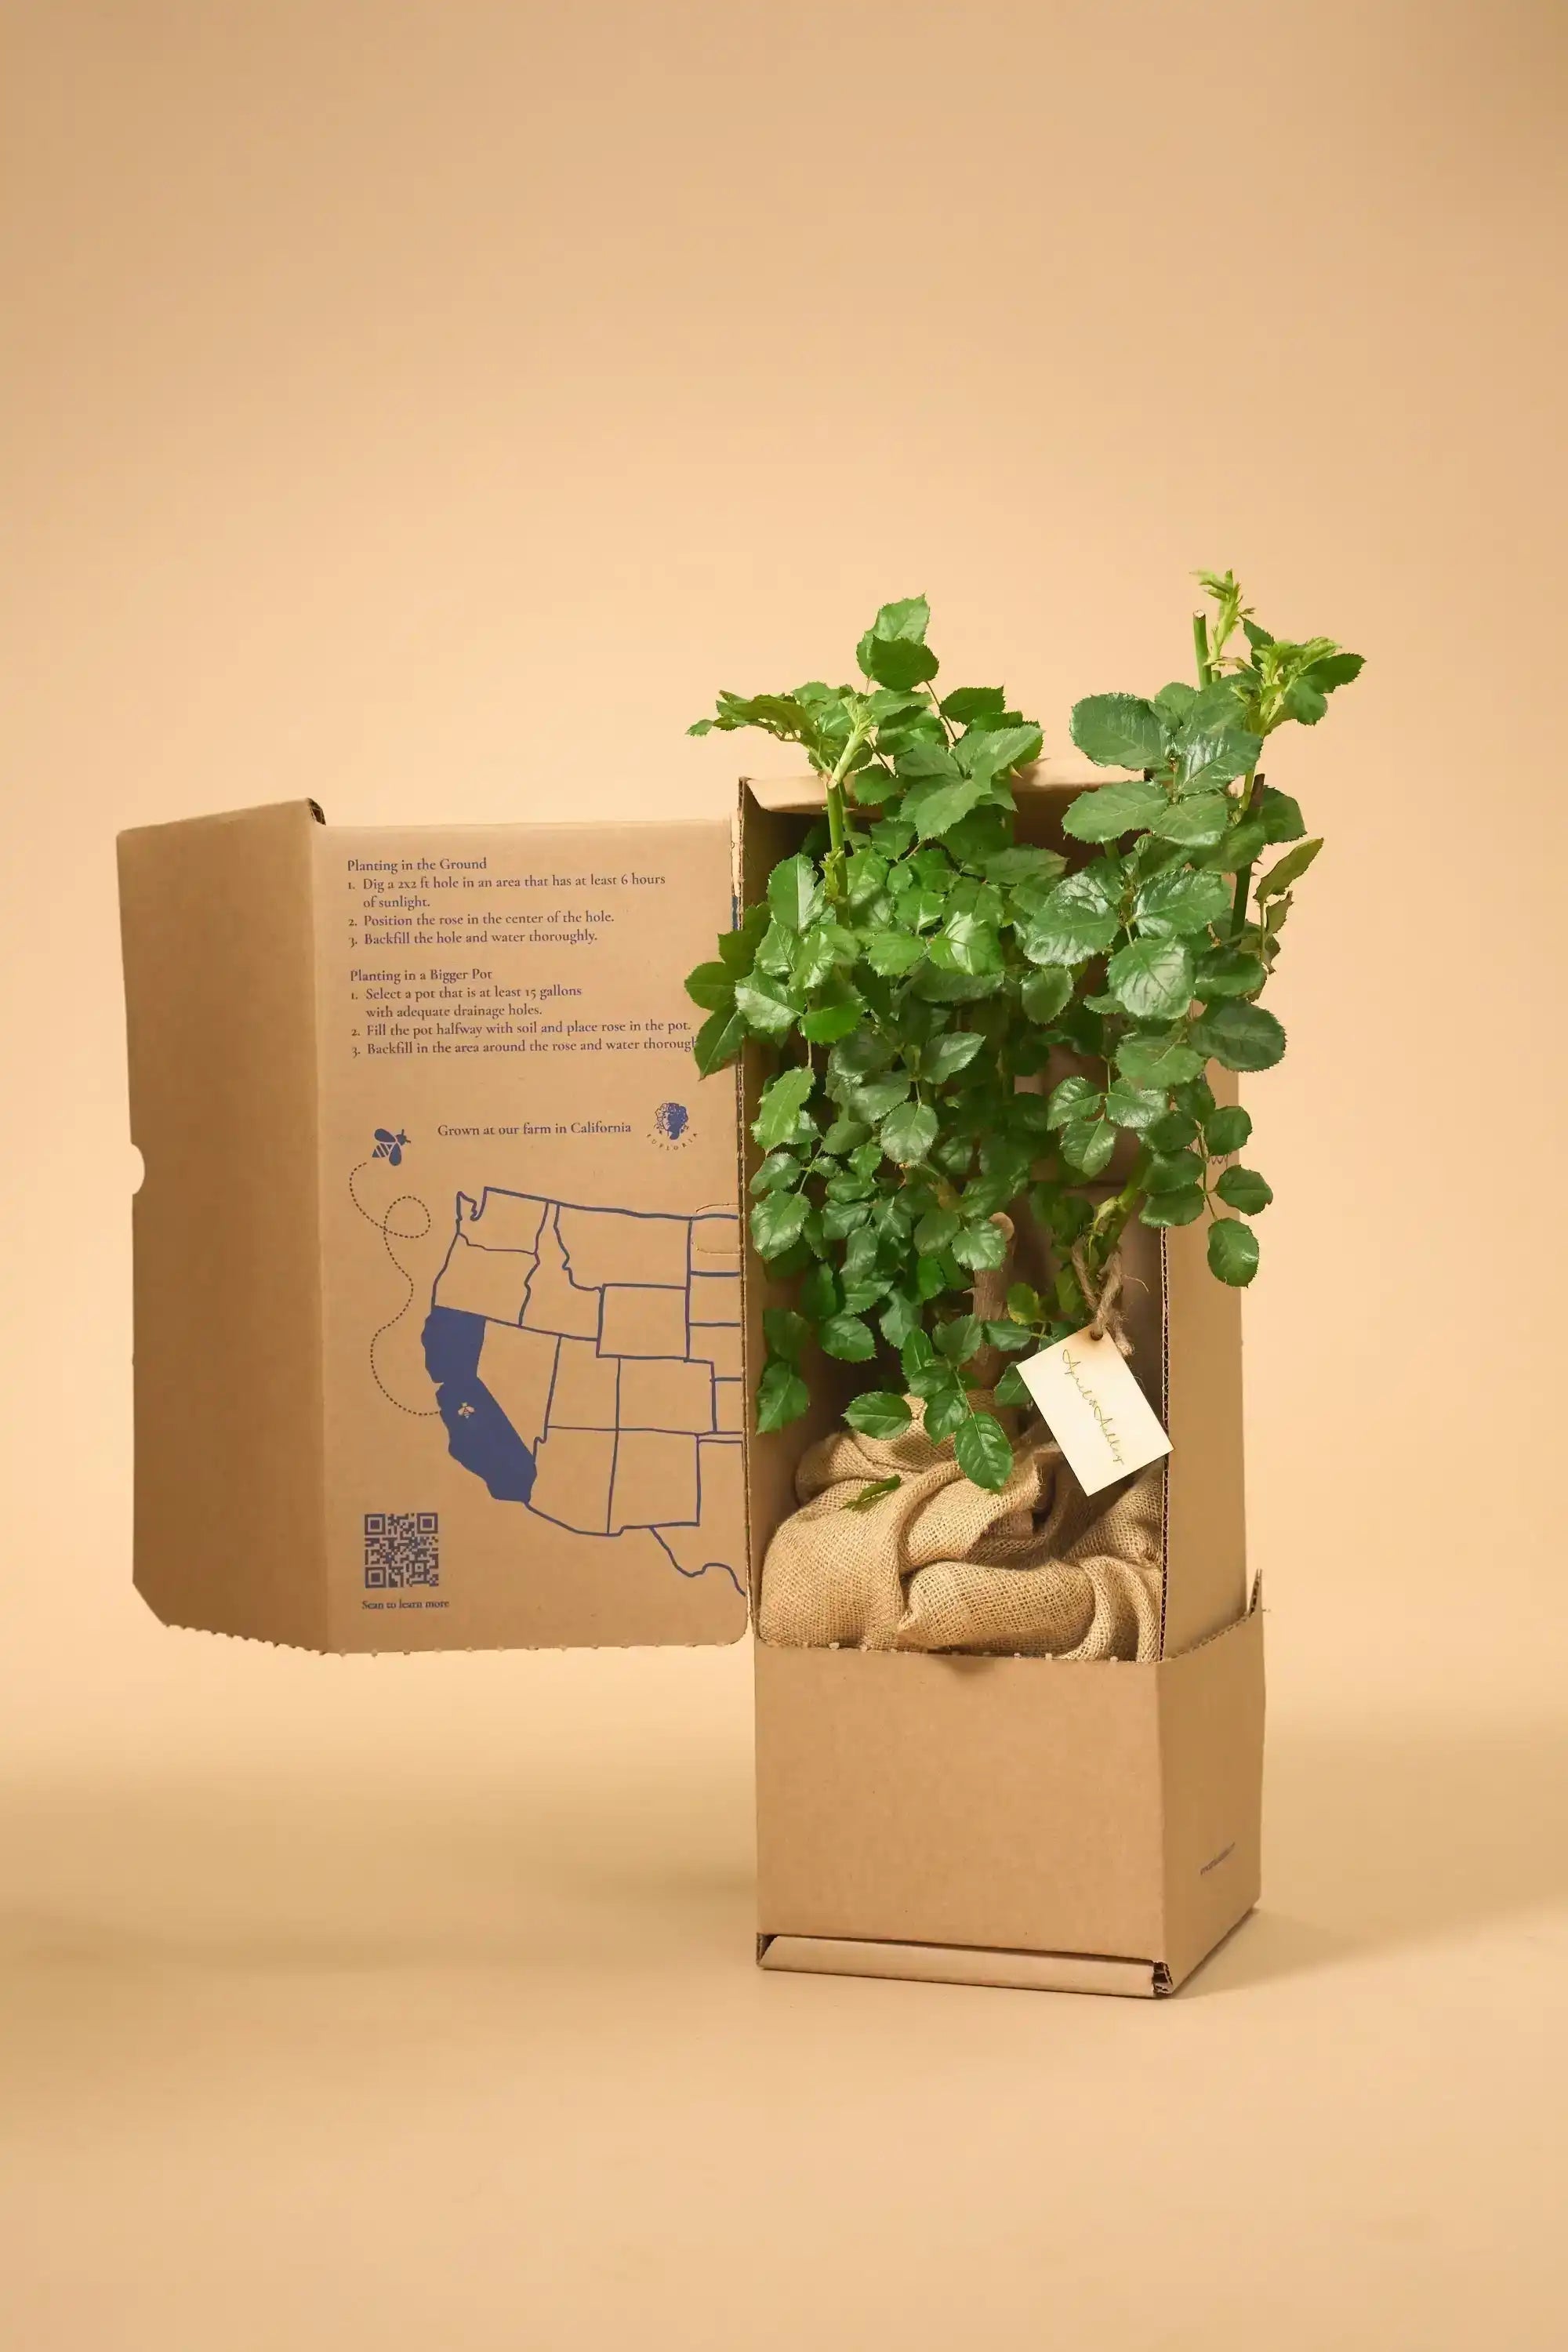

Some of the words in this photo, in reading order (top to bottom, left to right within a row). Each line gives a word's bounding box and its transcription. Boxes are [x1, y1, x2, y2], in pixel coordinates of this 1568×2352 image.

[347, 858, 399, 876] Planting
[401, 859, 413, 871] in
[416, 857, 437, 870] the
[439, 856, 487, 870] Ground
[347, 881, 356, 890] 1.
[363, 878, 385, 894] Dig
[387, 881, 395, 890] a
[419, 875, 430, 889] ft
[433, 876, 459, 889] hole
[463, 876, 474, 888] in
[477, 880, 492, 888] an
[495, 879, 521, 887] area
[524, 874, 549, 887] that
[551, 874, 572, 887] has
[575, 877, 587, 886] at
[590, 873, 618, 886] least
[620, 873, 629, 885] 6
[631, 871, 666, 885] hours
[362, 895, 378, 909] of
[378, 895, 431, 912] sunlight.
[348, 918, 358, 927] 2.
[364, 914, 412, 927] Position
[416, 912, 436, 926] the
[438, 916, 464, 926] rose
[466, 913, 479, 925] in
[482, 911, 503, 924] the
[505, 915, 544, 924] center
[546, 909, 561, 924] of
[562, 909, 583, 923] the
[585, 909, 615, 923] hole.
[349, 937, 358, 949] 3.
[364, 931, 410, 945] Backfill
[413, 931, 434, 944] the
[436, 931, 463, 944] hole
[465, 930, 488, 943] and
[490, 934, 526, 942] water
[529, 927, 598, 946] thoroughly.
[350, 968, 402, 985] Planting
[404, 969, 416, 981] in
[419, 972, 426, 981] a
[430, 968, 469, 985] Bigger
[472, 967, 493, 980] Pot
[350, 992, 358, 1000] 1.
[365, 986, 402, 1000] Select
[405, 990, 412, 1000] a
[414, 990, 437, 1004] pot
[438, 985, 463, 999] that
[466, 987, 477, 998] is
[479, 988, 492, 998] at
[493, 984, 522, 998] least
[524, 988, 537, 1000] 15
[539, 983, 583, 1001] gallons
[365, 1004, 394, 1018] with
[396, 1004, 451, 1022] adequate
[453, 1004, 506, 1020] drainage
[508, 1003, 543, 1016] holes.
[350, 1028, 361, 1036] 2.
[367, 1022, 387, 1036] Fill
[390, 1022, 410, 1036] the
[412, 1026, 434, 1040] pot
[436, 1022, 483, 1039] halfway
[485, 1021, 514, 1034] with
[516, 1020, 537, 1034] soil
[540, 1020, 563, 1034] and
[566, 1019, 598, 1037] place
[601, 1023, 626, 1033] rose
[630, 1020, 641, 1032] in
[644, 1018, 665, 1032] the
[667, 1022, 691, 1036] pot.
[351, 1047, 361, 1059] 3.
[367, 1040, 413, 1054] Backfill
[416, 1042, 429, 1054] in
[432, 1040, 452, 1054] the
[454, 1044, 480, 1053] area
[482, 1039, 526, 1053] around
[529, 1039, 549, 1051] the
[552, 1043, 577, 1051] rose
[579, 1037, 603, 1051] and
[605, 1041, 641, 1050] water
[437, 1124, 481, 1137] Grown
[482, 1127, 495, 1135] at
[498, 1127, 520, 1135] our
[523, 1121, 552, 1136] farm
[554, 1123, 568, 1134] in
[570, 1120, 632, 1134] California
[361, 1599, 384, 1610] Scan
[398, 1597, 423, 1609] learn
[425, 1600, 450, 1609] more
